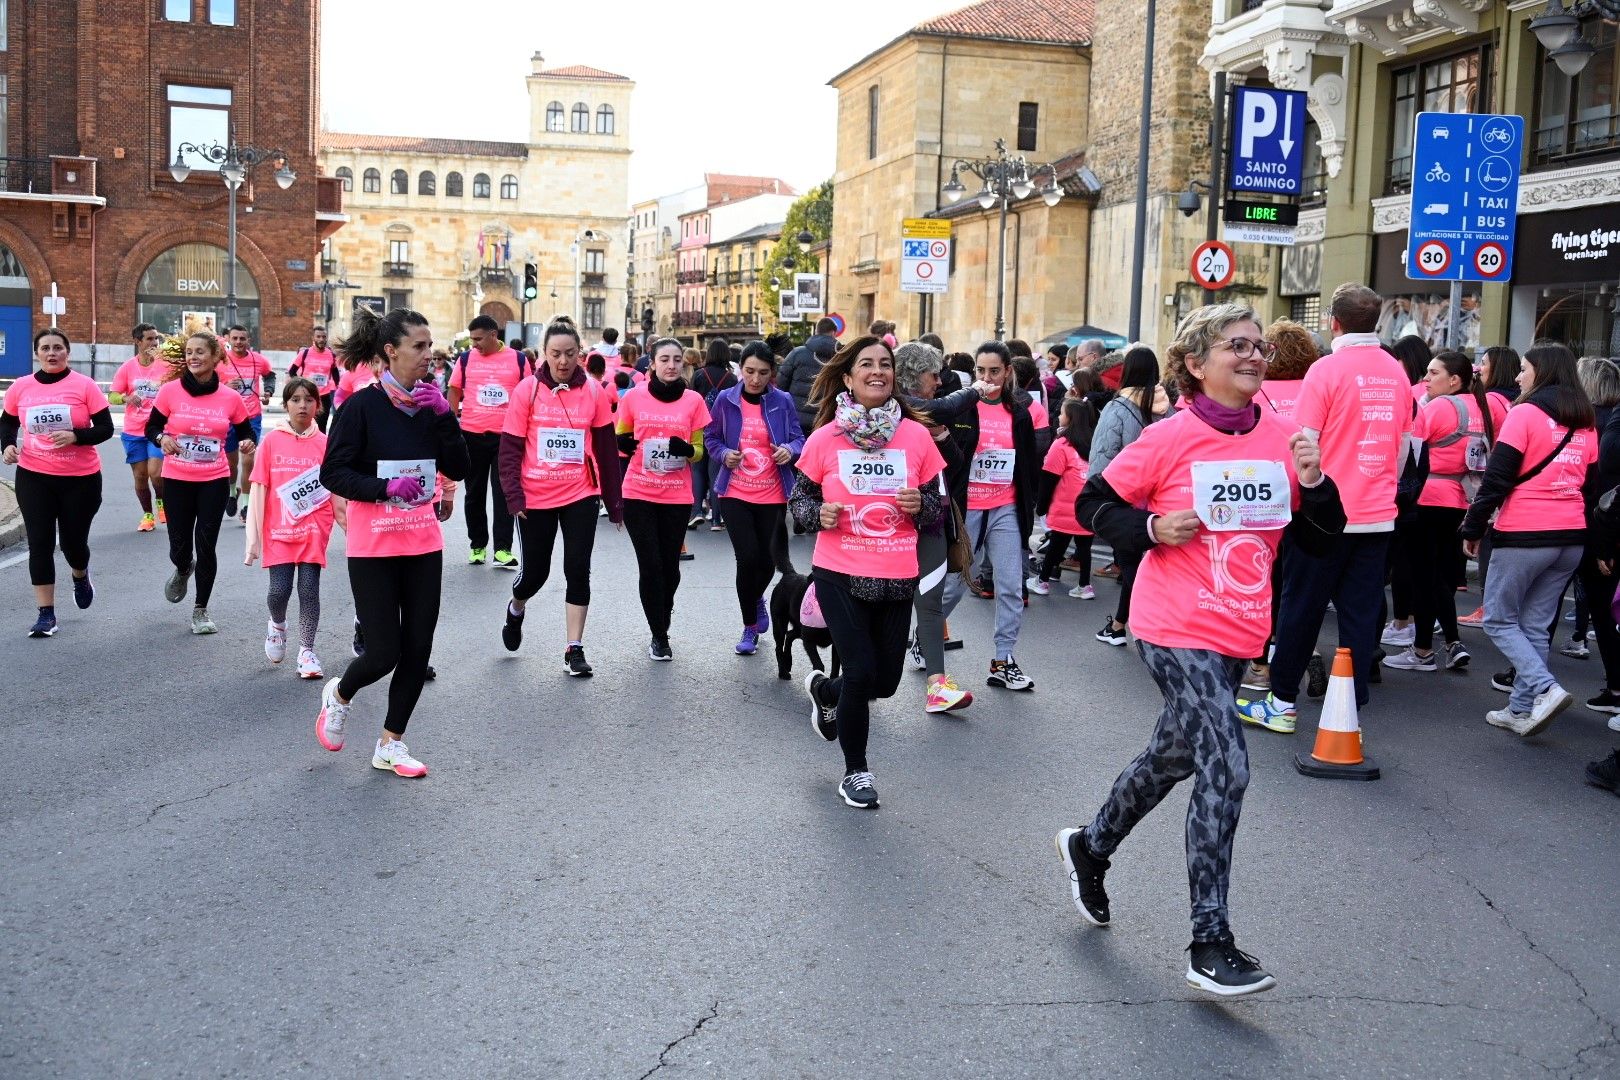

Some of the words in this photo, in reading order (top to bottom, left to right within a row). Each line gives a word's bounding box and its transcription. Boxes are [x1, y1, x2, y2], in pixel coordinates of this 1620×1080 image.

[1240, 90, 1277, 158] P
[1246, 160, 1287, 174] SANTO
[1235, 174, 1296, 190] DOMINGO
[1478, 196, 1508, 209] TAXI
[1245, 206, 1278, 220] LIBRE
[1477, 216, 1506, 228] BUS
[1552, 231, 1588, 252] flying
[1423, 252, 1443, 263] 30
[1480, 254, 1498, 266] 20
[1564, 249, 1608, 260] copenhagen
[177, 279, 219, 291] BBVA
[33, 414, 63, 423] 1936
[1361, 412, 1393, 421] ZAPICO
[185, 442, 211, 453] 1766
[547, 439, 576, 449] 0993
[852, 463, 894, 476] 2906
[978, 460, 1007, 469] 1977
[291, 479, 321, 501] 0852
[1212, 484, 1272, 502] 2905
[371, 517, 404, 526] CARRERA
[842, 536, 876, 545] CARRERA
[841, 543, 865, 552] almom
[1199, 600, 1230, 616] almom
[1242, 601, 1255, 610] DE
